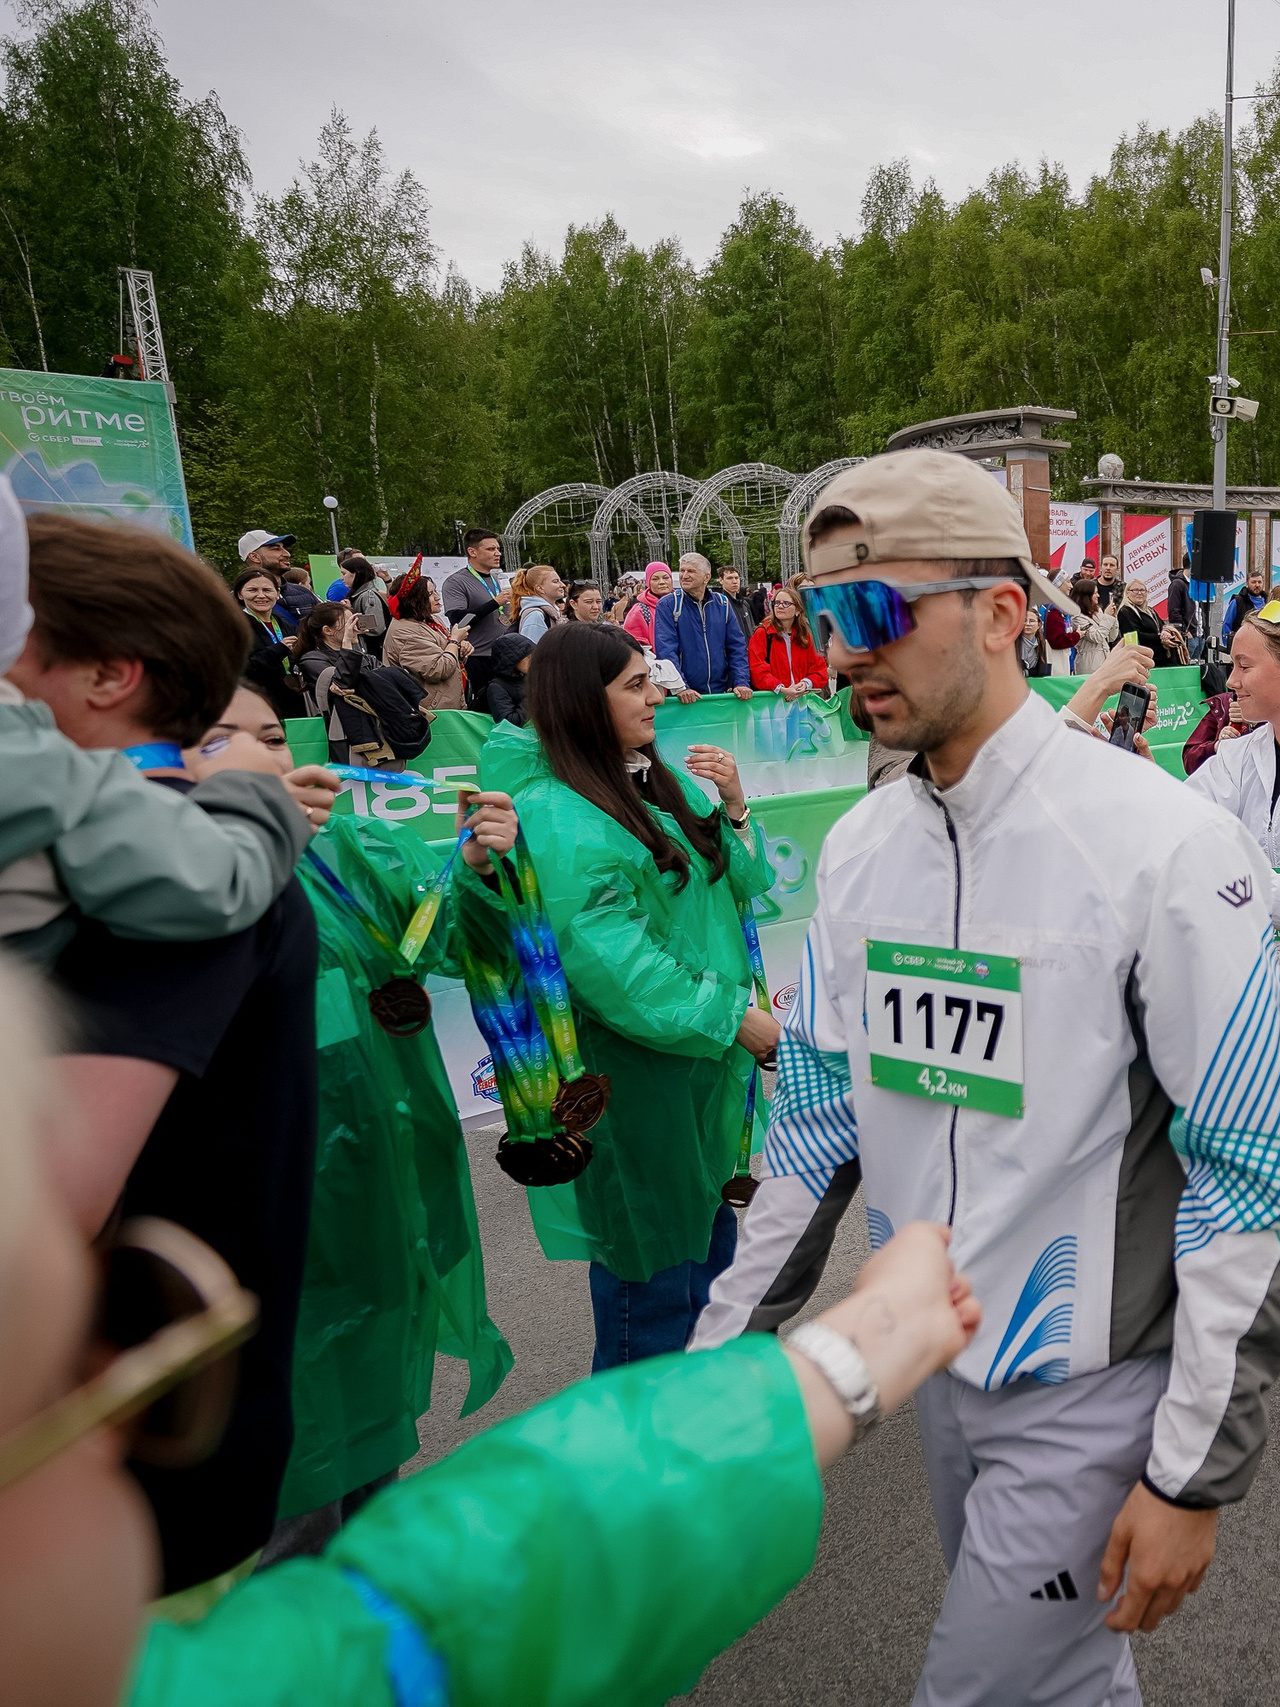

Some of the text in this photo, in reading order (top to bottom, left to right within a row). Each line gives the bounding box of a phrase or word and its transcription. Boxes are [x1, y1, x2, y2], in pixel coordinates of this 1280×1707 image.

[0, 391, 66, 406] твоём
[20, 406, 146, 432] ритме
[42, 435, 70, 443] СБЕР
[1050, 509, 1068, 517] ВАЛЬ
[1126, 543, 1168, 574] ПЕРВЫХ
[1128, 531, 1167, 560] ДВИЖЕНИЕ
[1155, 717, 1173, 730] фон
[334, 765, 478, 821] 185
[884, 987, 1005, 1061] 1177
